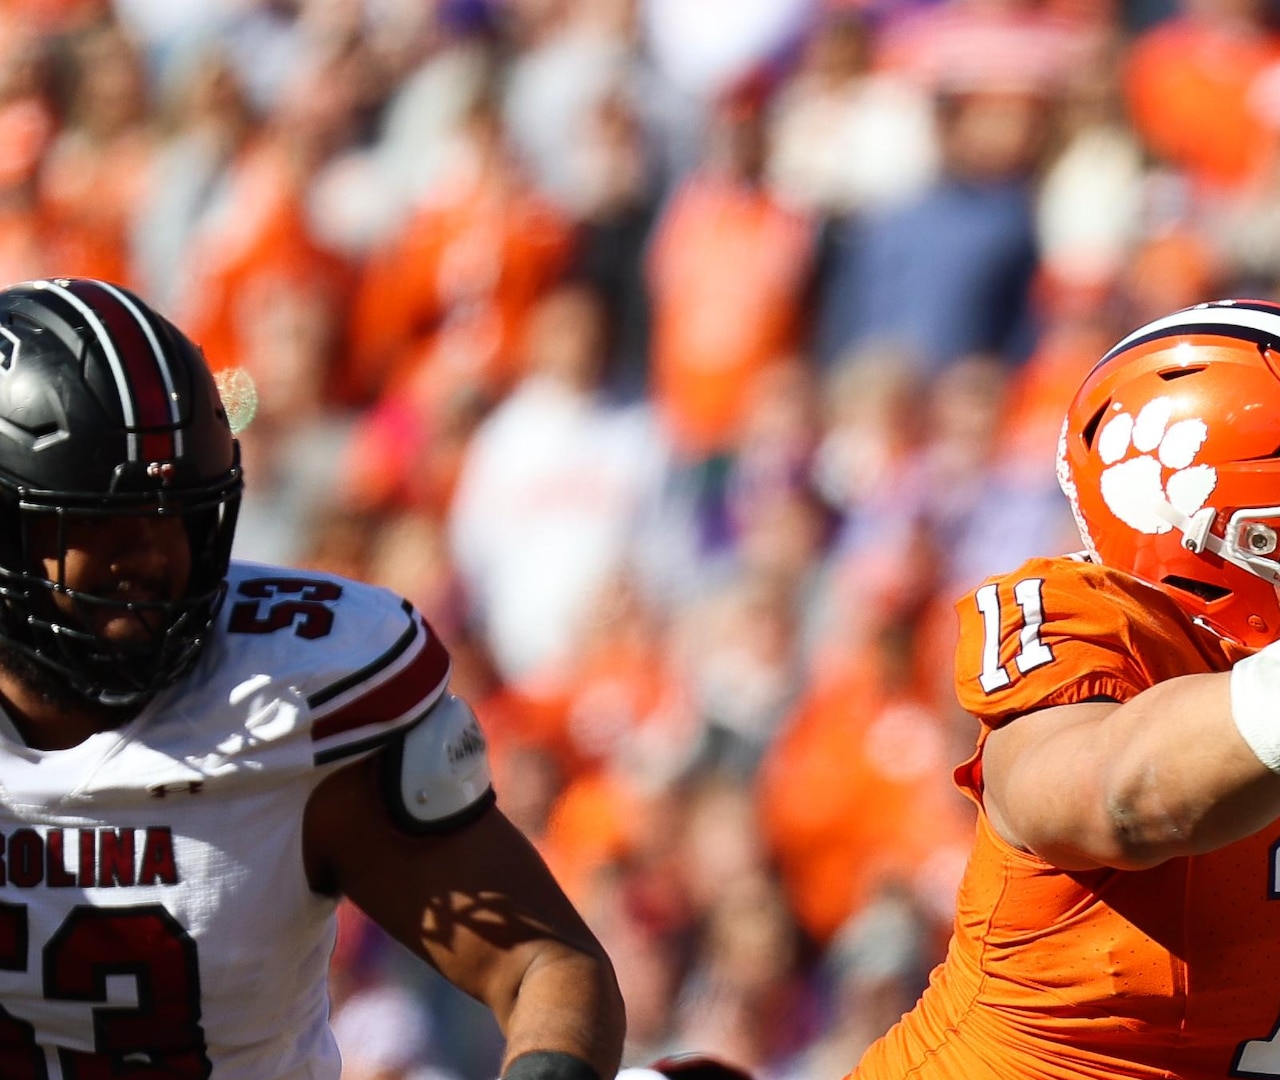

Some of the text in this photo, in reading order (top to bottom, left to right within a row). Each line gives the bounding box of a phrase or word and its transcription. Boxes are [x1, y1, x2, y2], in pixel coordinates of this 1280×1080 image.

[227, 576, 343, 640] 53
[974, 577, 1057, 697] 11
[0, 826, 180, 888] OLINA
